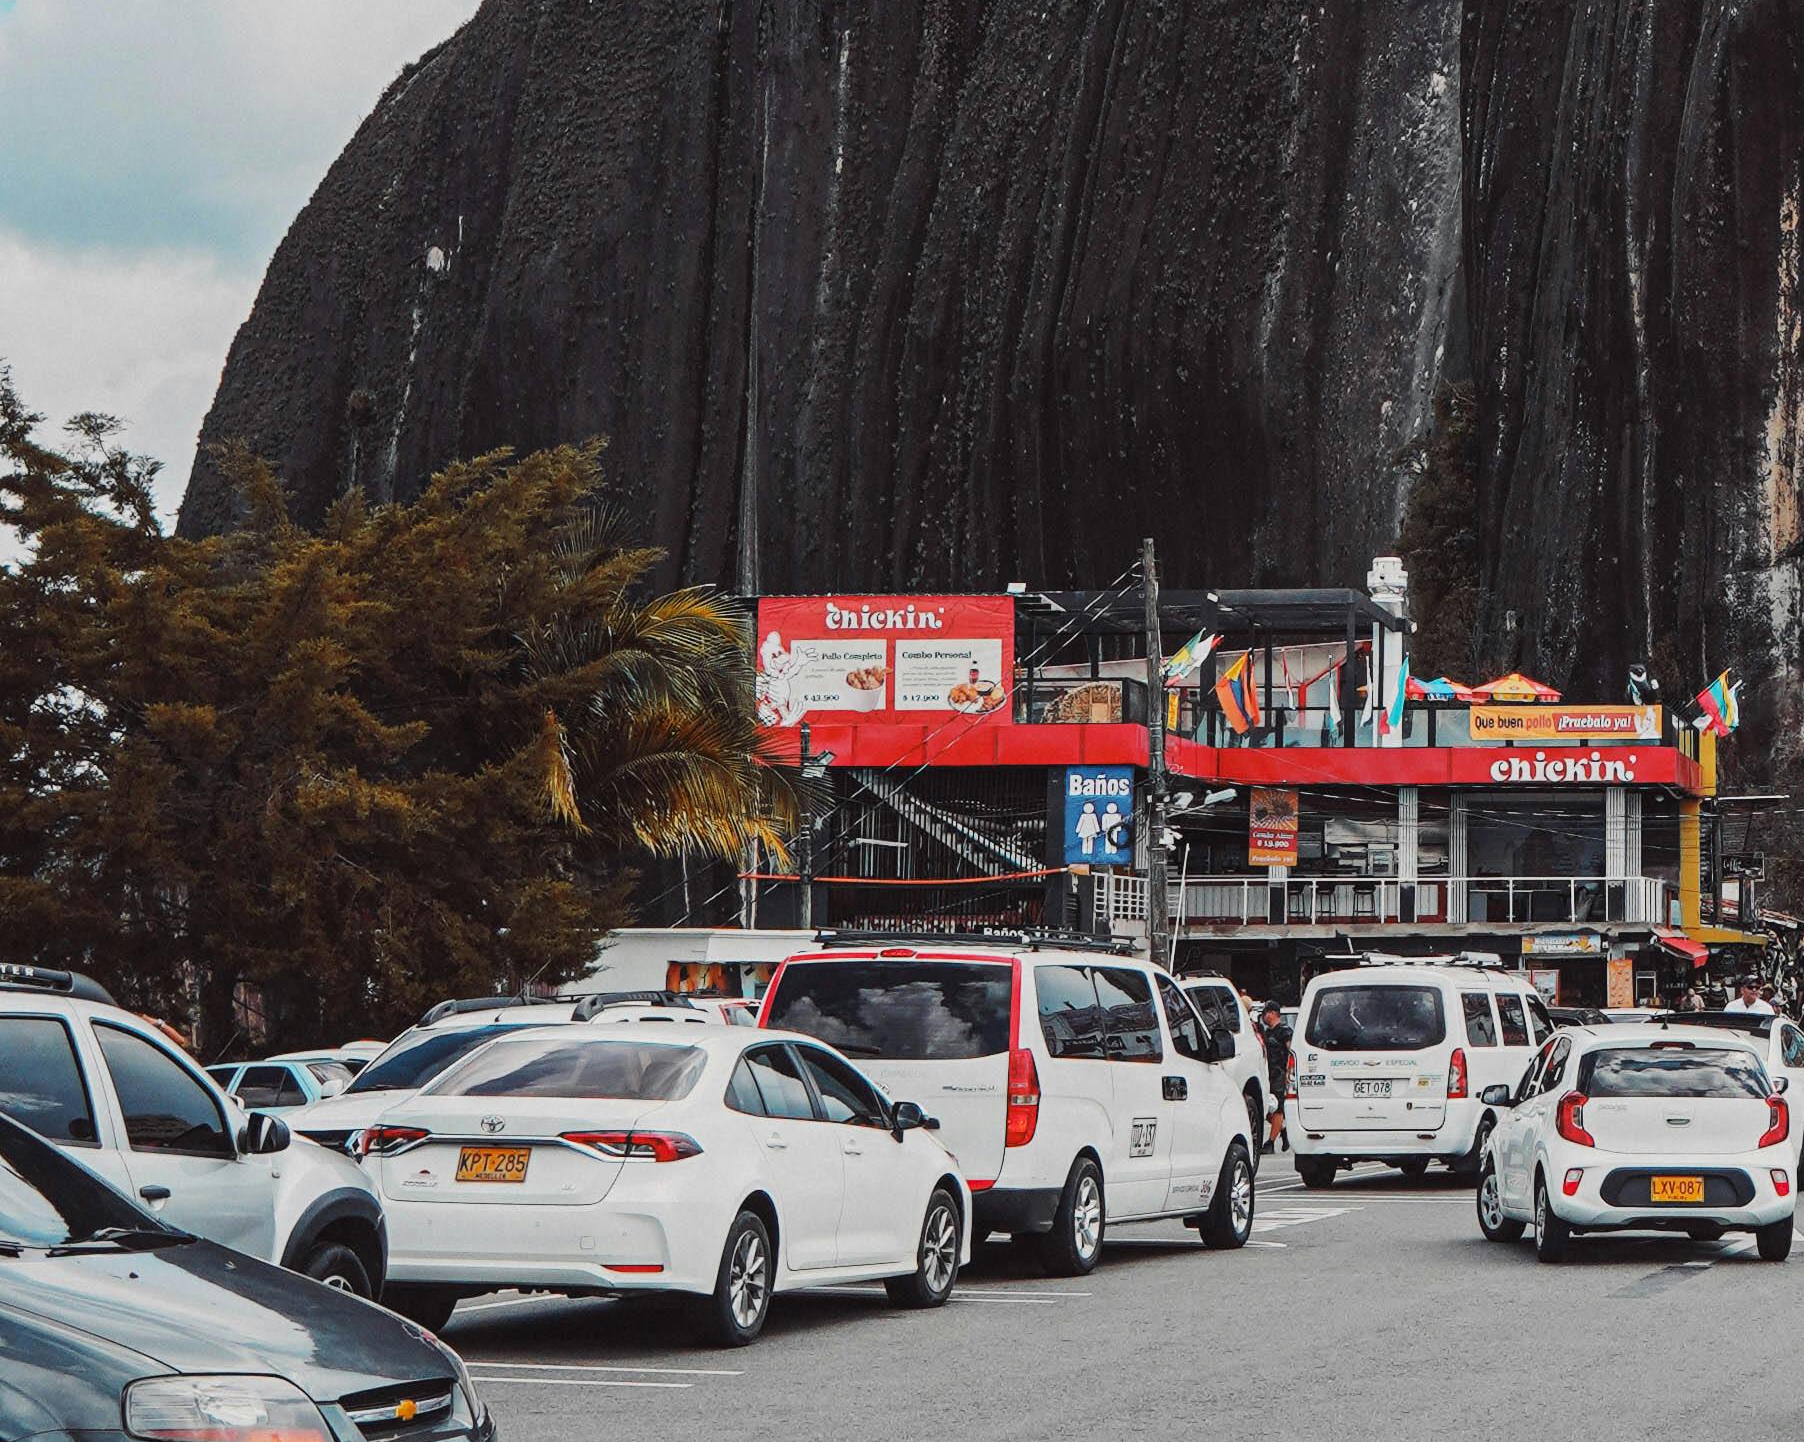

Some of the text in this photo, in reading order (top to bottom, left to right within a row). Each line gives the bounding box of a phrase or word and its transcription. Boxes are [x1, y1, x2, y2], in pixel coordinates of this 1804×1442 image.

[902, 650, 972, 659] Combo Personal
[1475, 716, 1495, 730] Que
[1497, 716, 1524, 729] buen
[1526, 716, 1551, 731] pollo
[1613, 716, 1632, 731] ya!
[1069, 774, 1130, 796] Baños
[1353, 1082, 1391, 1094] GET 078
